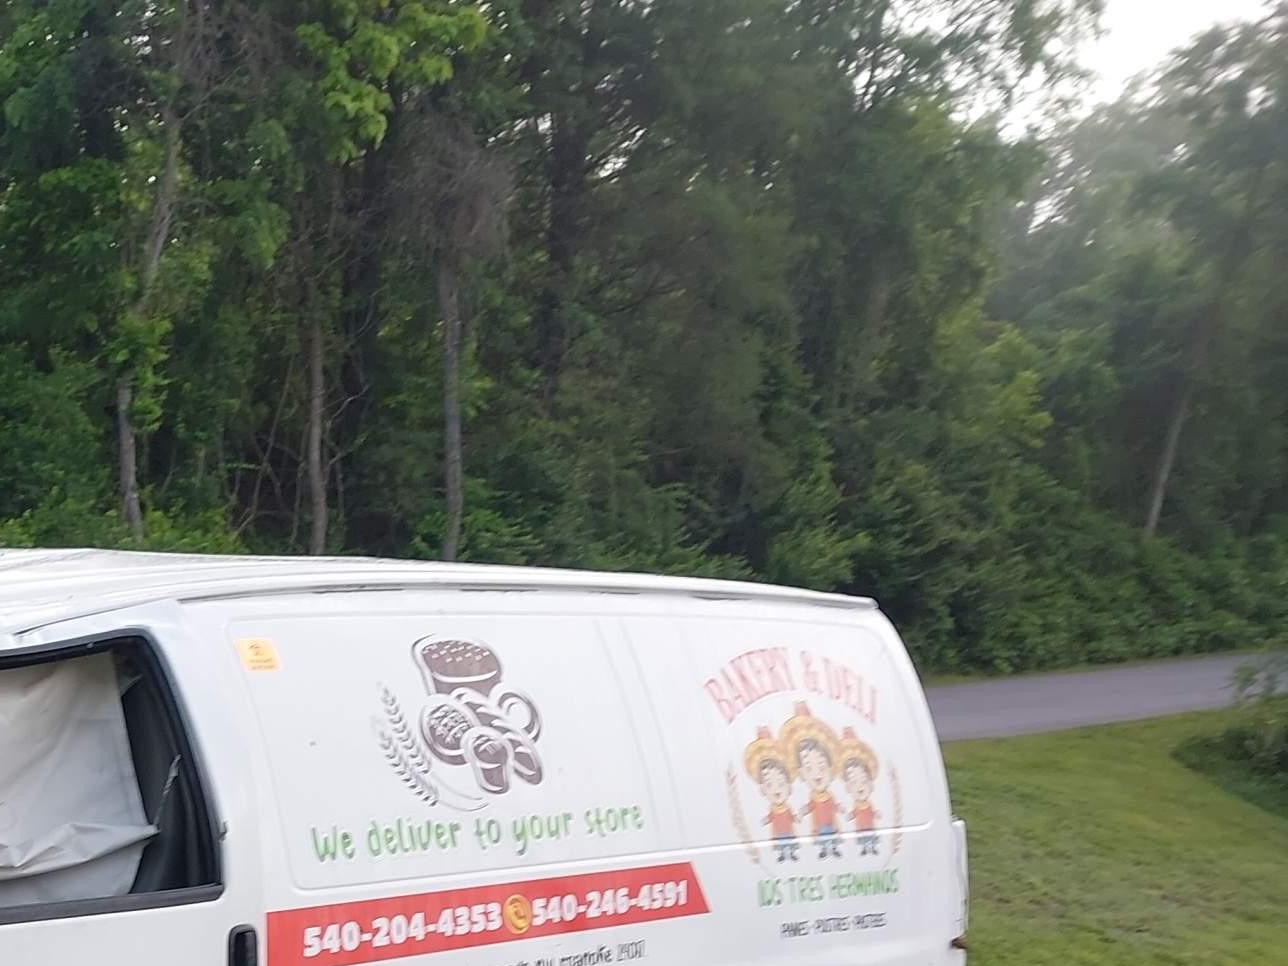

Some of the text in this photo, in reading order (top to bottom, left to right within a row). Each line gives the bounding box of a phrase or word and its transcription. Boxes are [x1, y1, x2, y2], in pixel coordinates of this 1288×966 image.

[311, 805, 645, 863] We deliver to your store
[302, 880, 689, 958] 540-204-4353 540-246-4591
